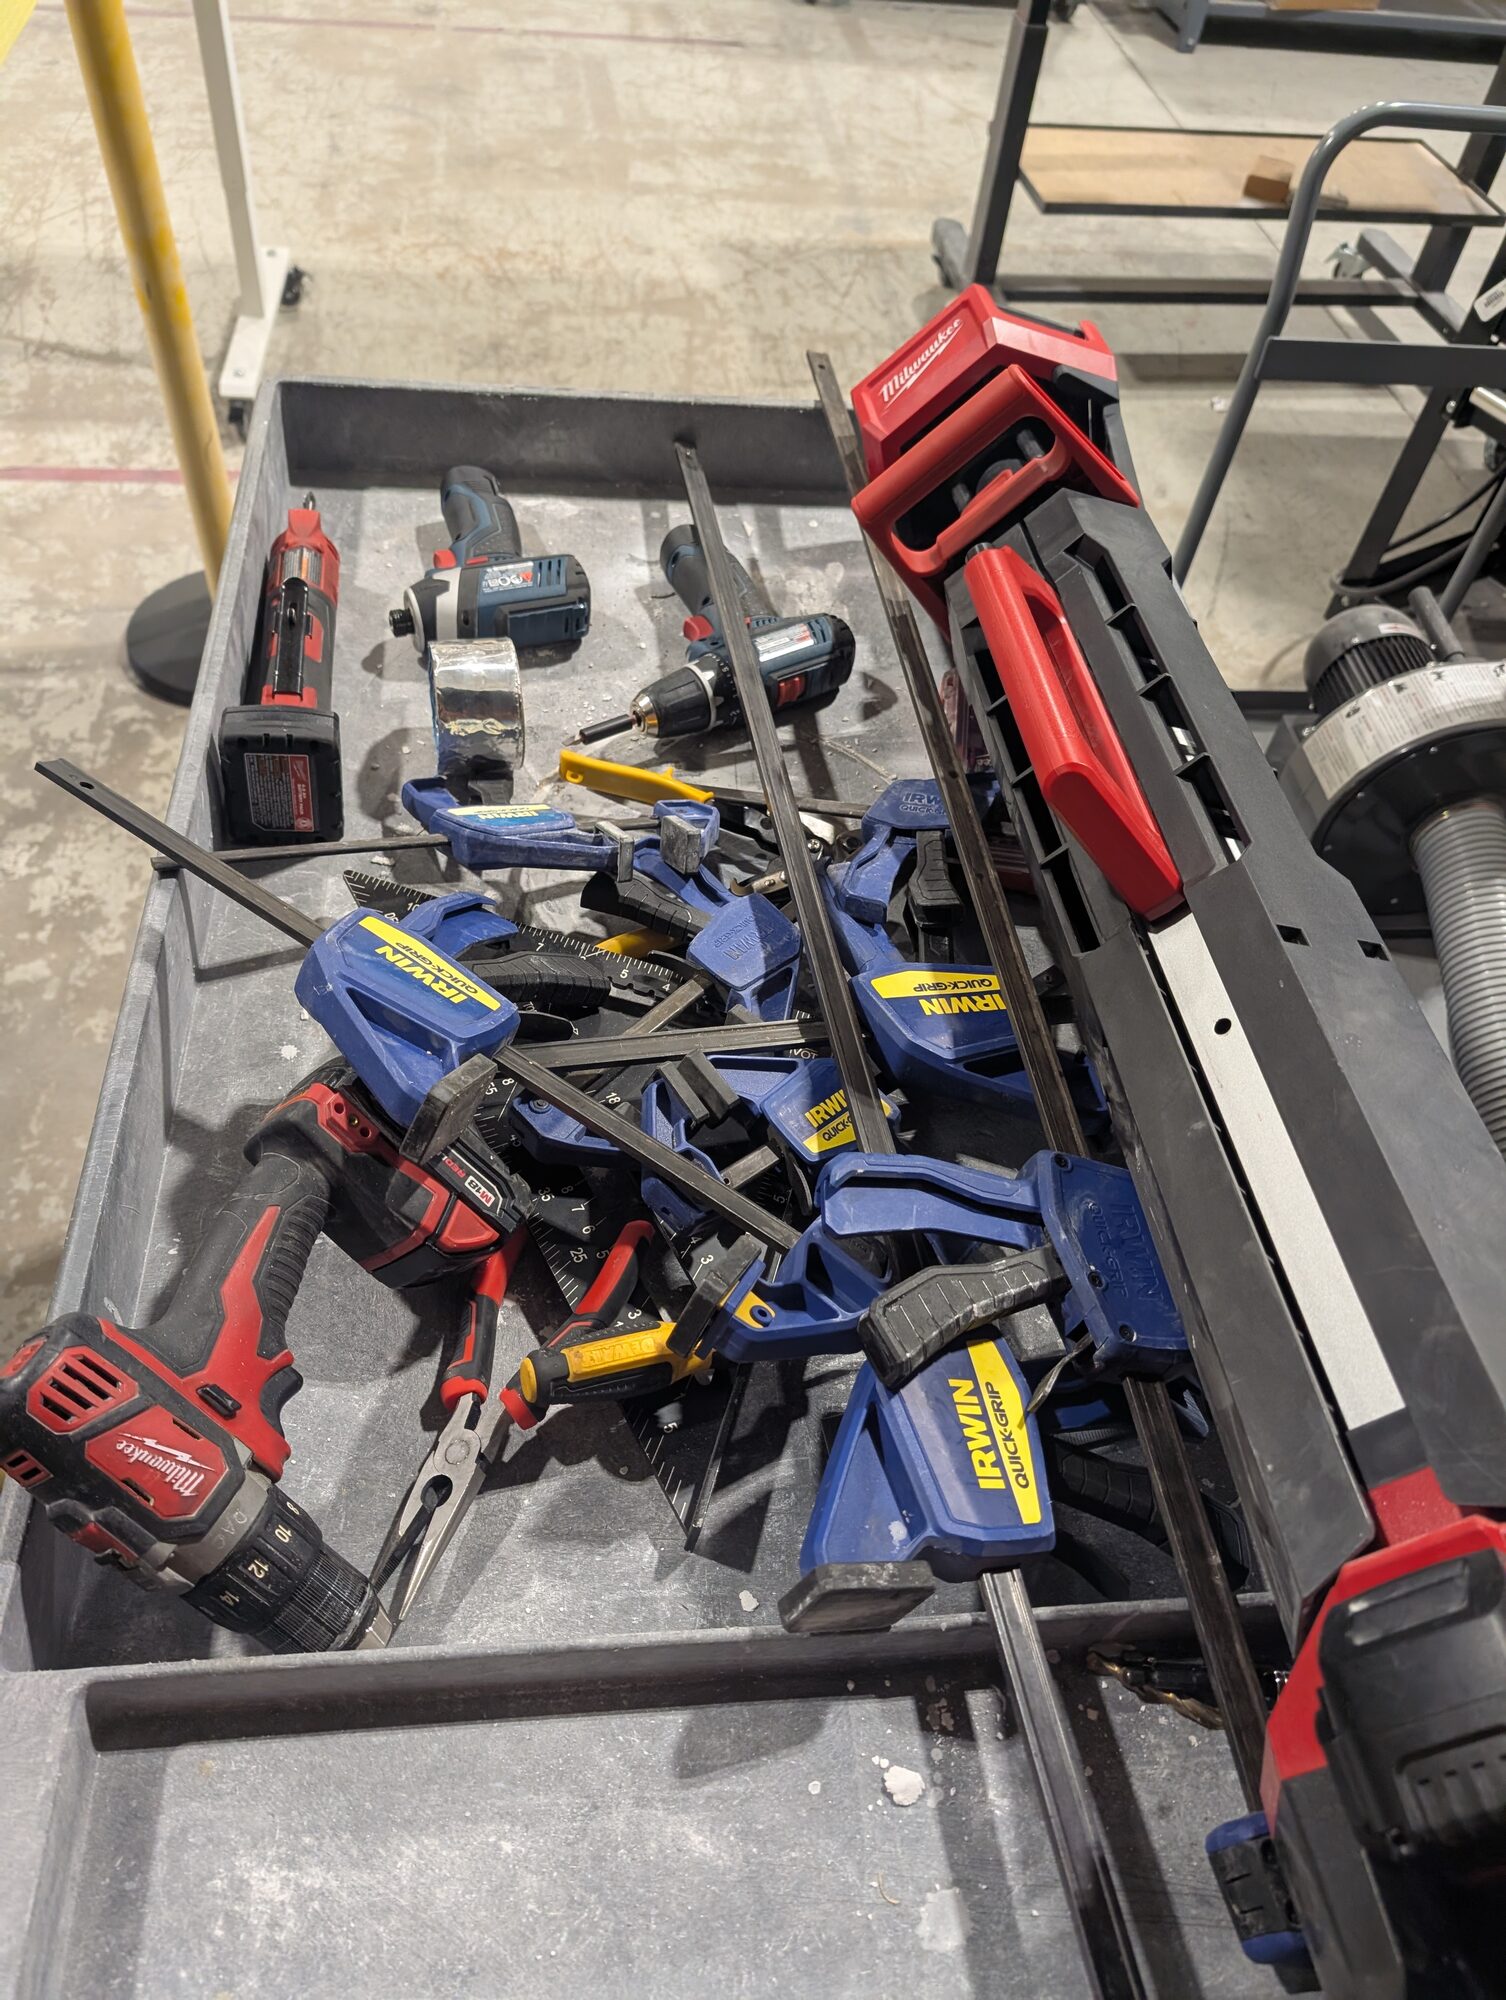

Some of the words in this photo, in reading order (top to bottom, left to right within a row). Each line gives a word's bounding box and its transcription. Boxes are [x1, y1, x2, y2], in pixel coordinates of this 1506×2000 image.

[878, 319, 960, 402] Milwaukee
[902, 792, 942, 805] IRW
[536, 943, 544, 951] 7
[375, 945, 469, 1004] IRWIN
[619, 969, 629, 979] 5
[661, 983, 671, 992] 4
[919, 993, 1007, 1016] IRWIN
[502, 1077, 515, 1086] 8
[605, 1091, 621, 1104] 18
[466, 1179, 493, 1204] M18
[538, 1186, 556, 1202] 35
[571, 1204, 585, 1213] 7
[582, 1225, 596, 1235] 6
[569, 1247, 588, 1263] 25
[700, 1254, 714, 1265] 3
[627, 1308, 642, 1320] 3
[948, 1378, 1006, 1490] IRWIN
[116, 1439, 205, 1498] Milwaukee
[286, 1501, 300, 1516] 8
[274, 1524, 293, 1544] 10
[247, 1558, 270, 1579] 12
[219, 1590, 241, 1607] 14
